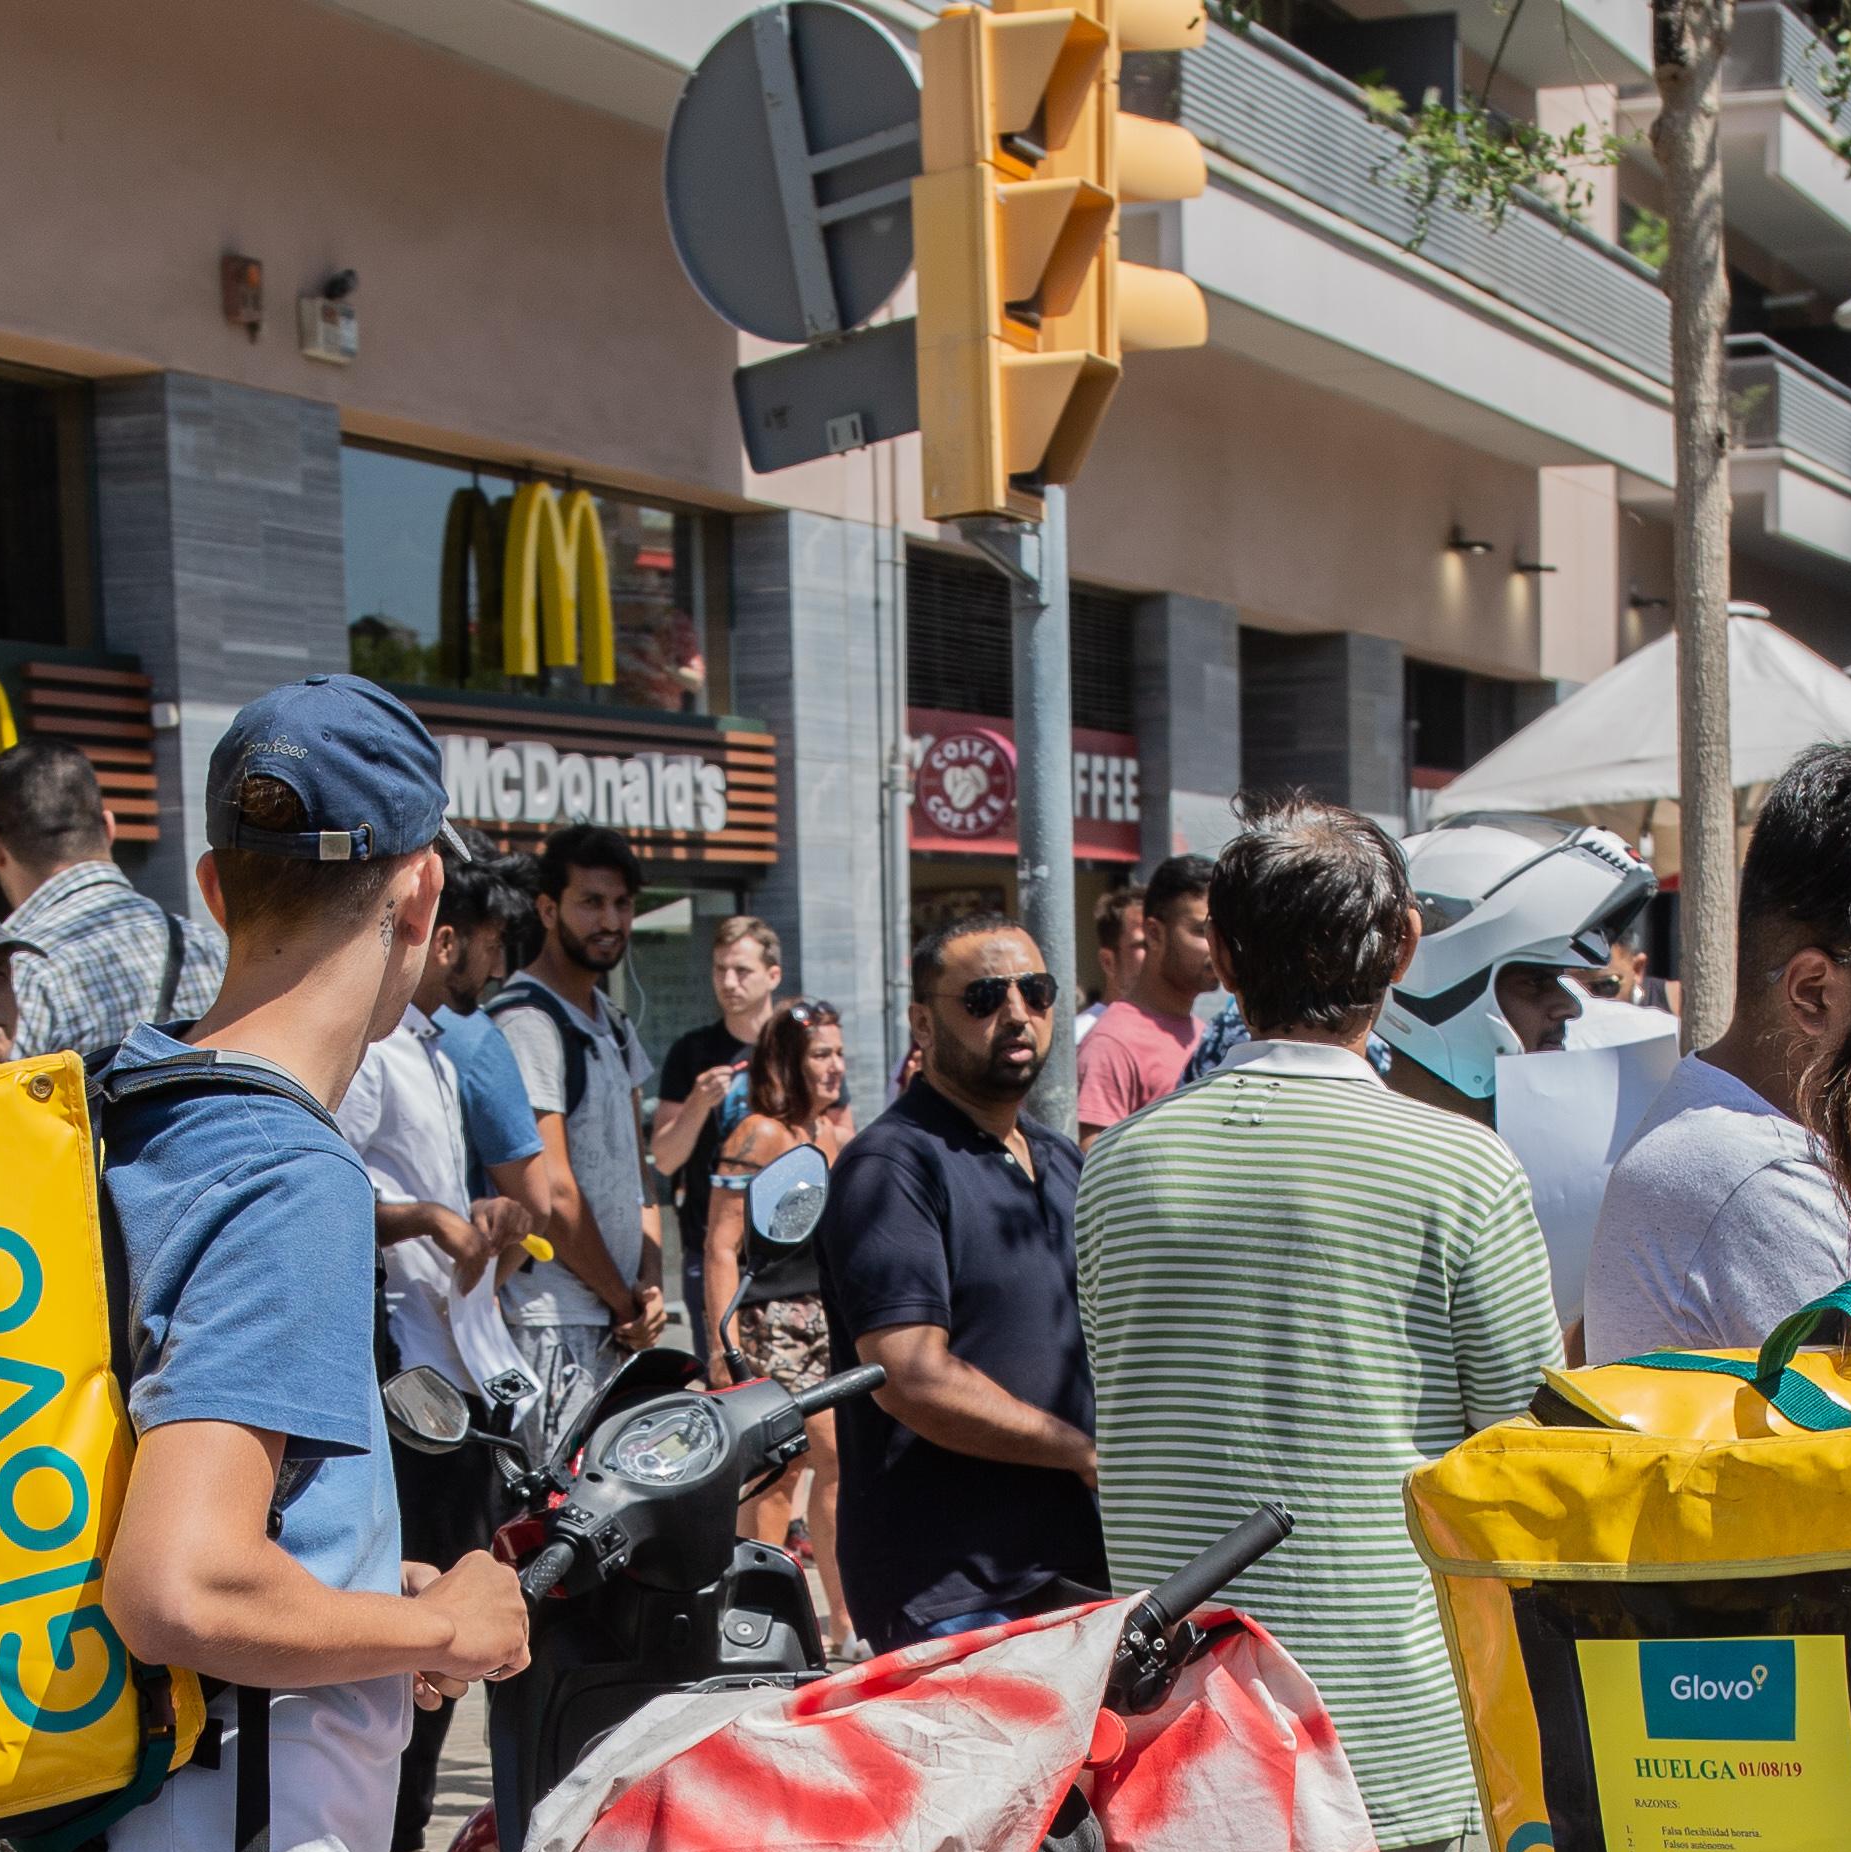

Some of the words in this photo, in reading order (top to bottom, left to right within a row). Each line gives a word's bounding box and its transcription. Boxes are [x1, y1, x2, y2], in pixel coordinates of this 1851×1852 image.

[931, 739, 995, 769] COSTA
[442, 734, 727, 832] McDonald's
[1073, 752, 1140, 821] FFEE
[927, 795, 1005, 830] COFFEE
[1670, 1674, 1753, 1701] Glovo
[1634, 1758, 1736, 1779] HUELGA
[1738, 1761, 1803, 1777] 01/08/19
[1634, 1798, 1680, 1809] RAZONES:
[1662, 1826, 1682, 1836] Falsa
[1684, 1826, 1729, 1837] flexibilidad
[1664, 1839, 1689, 1849] Falsos
